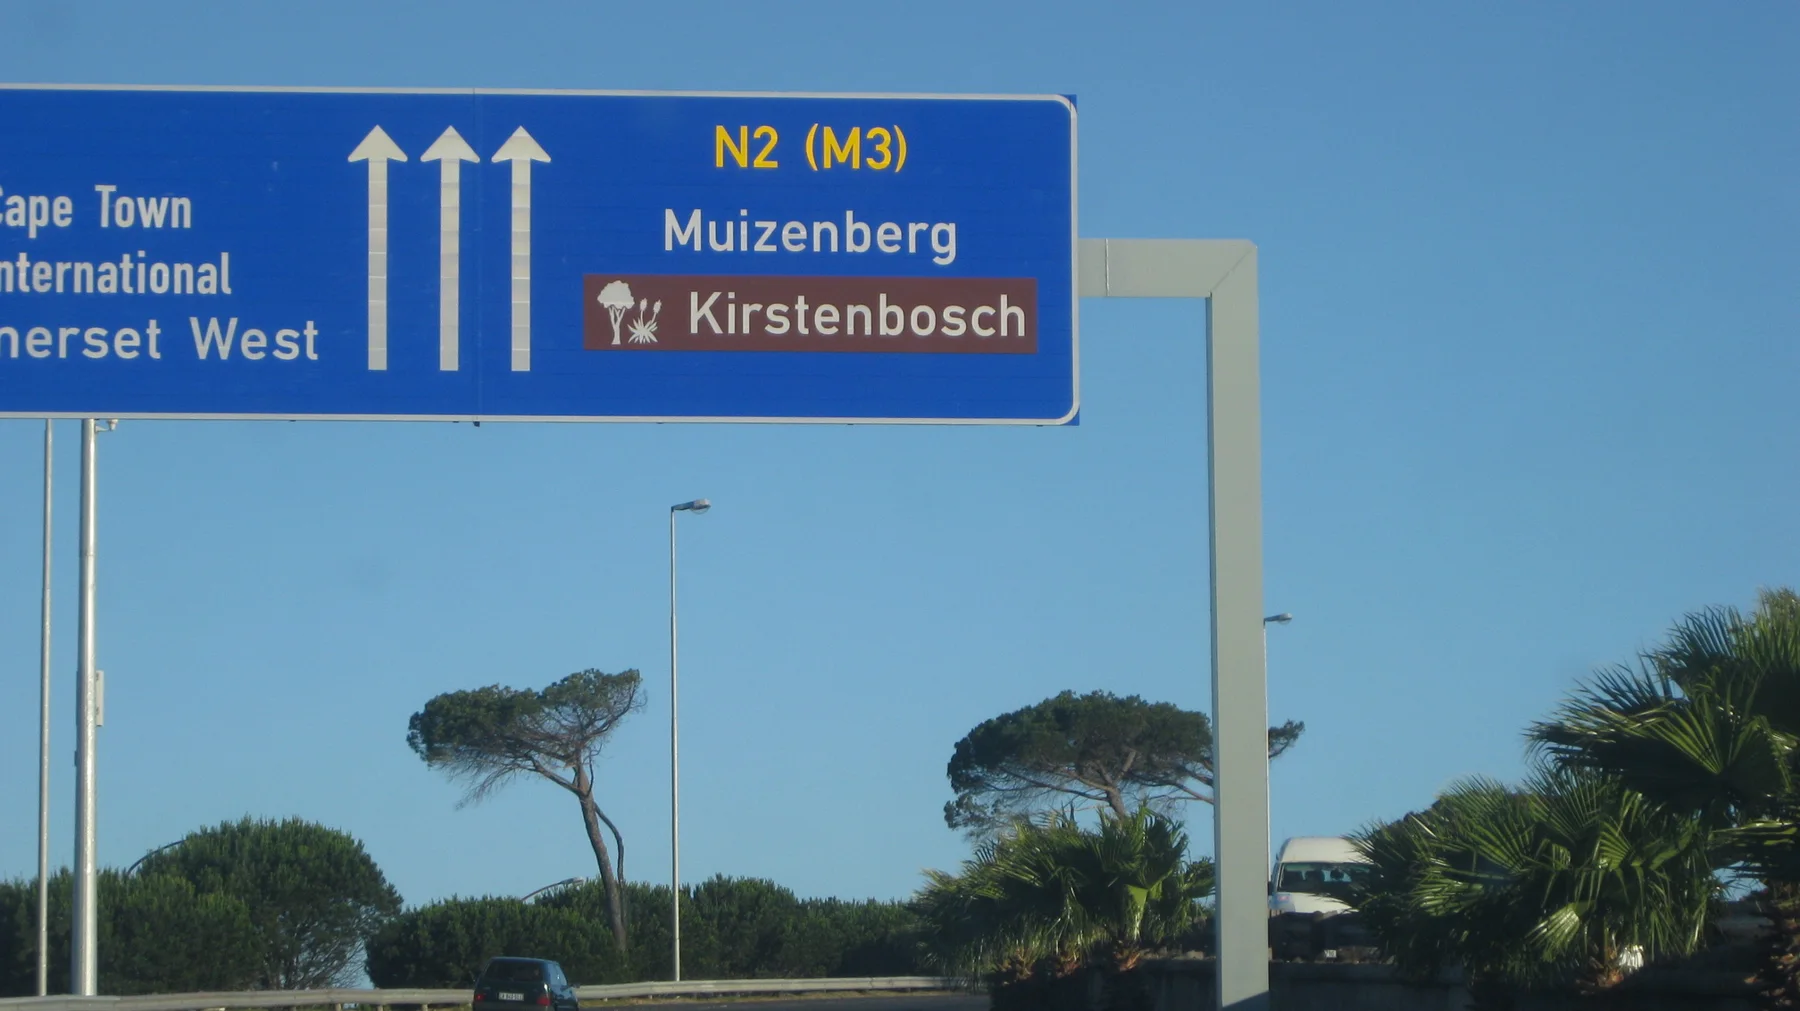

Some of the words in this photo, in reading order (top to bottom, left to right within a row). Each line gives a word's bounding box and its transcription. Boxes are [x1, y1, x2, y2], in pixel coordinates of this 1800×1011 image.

[715, 125, 779, 169] N2
[805, 123, 908, 173] (M3)
[0, 184, 73, 239] ape
[94, 184, 192, 228] Town
[664, 208, 957, 265] Muizenberg
[189, 317, 319, 361] West
[689, 291, 1026, 337] Kirstenbosch
